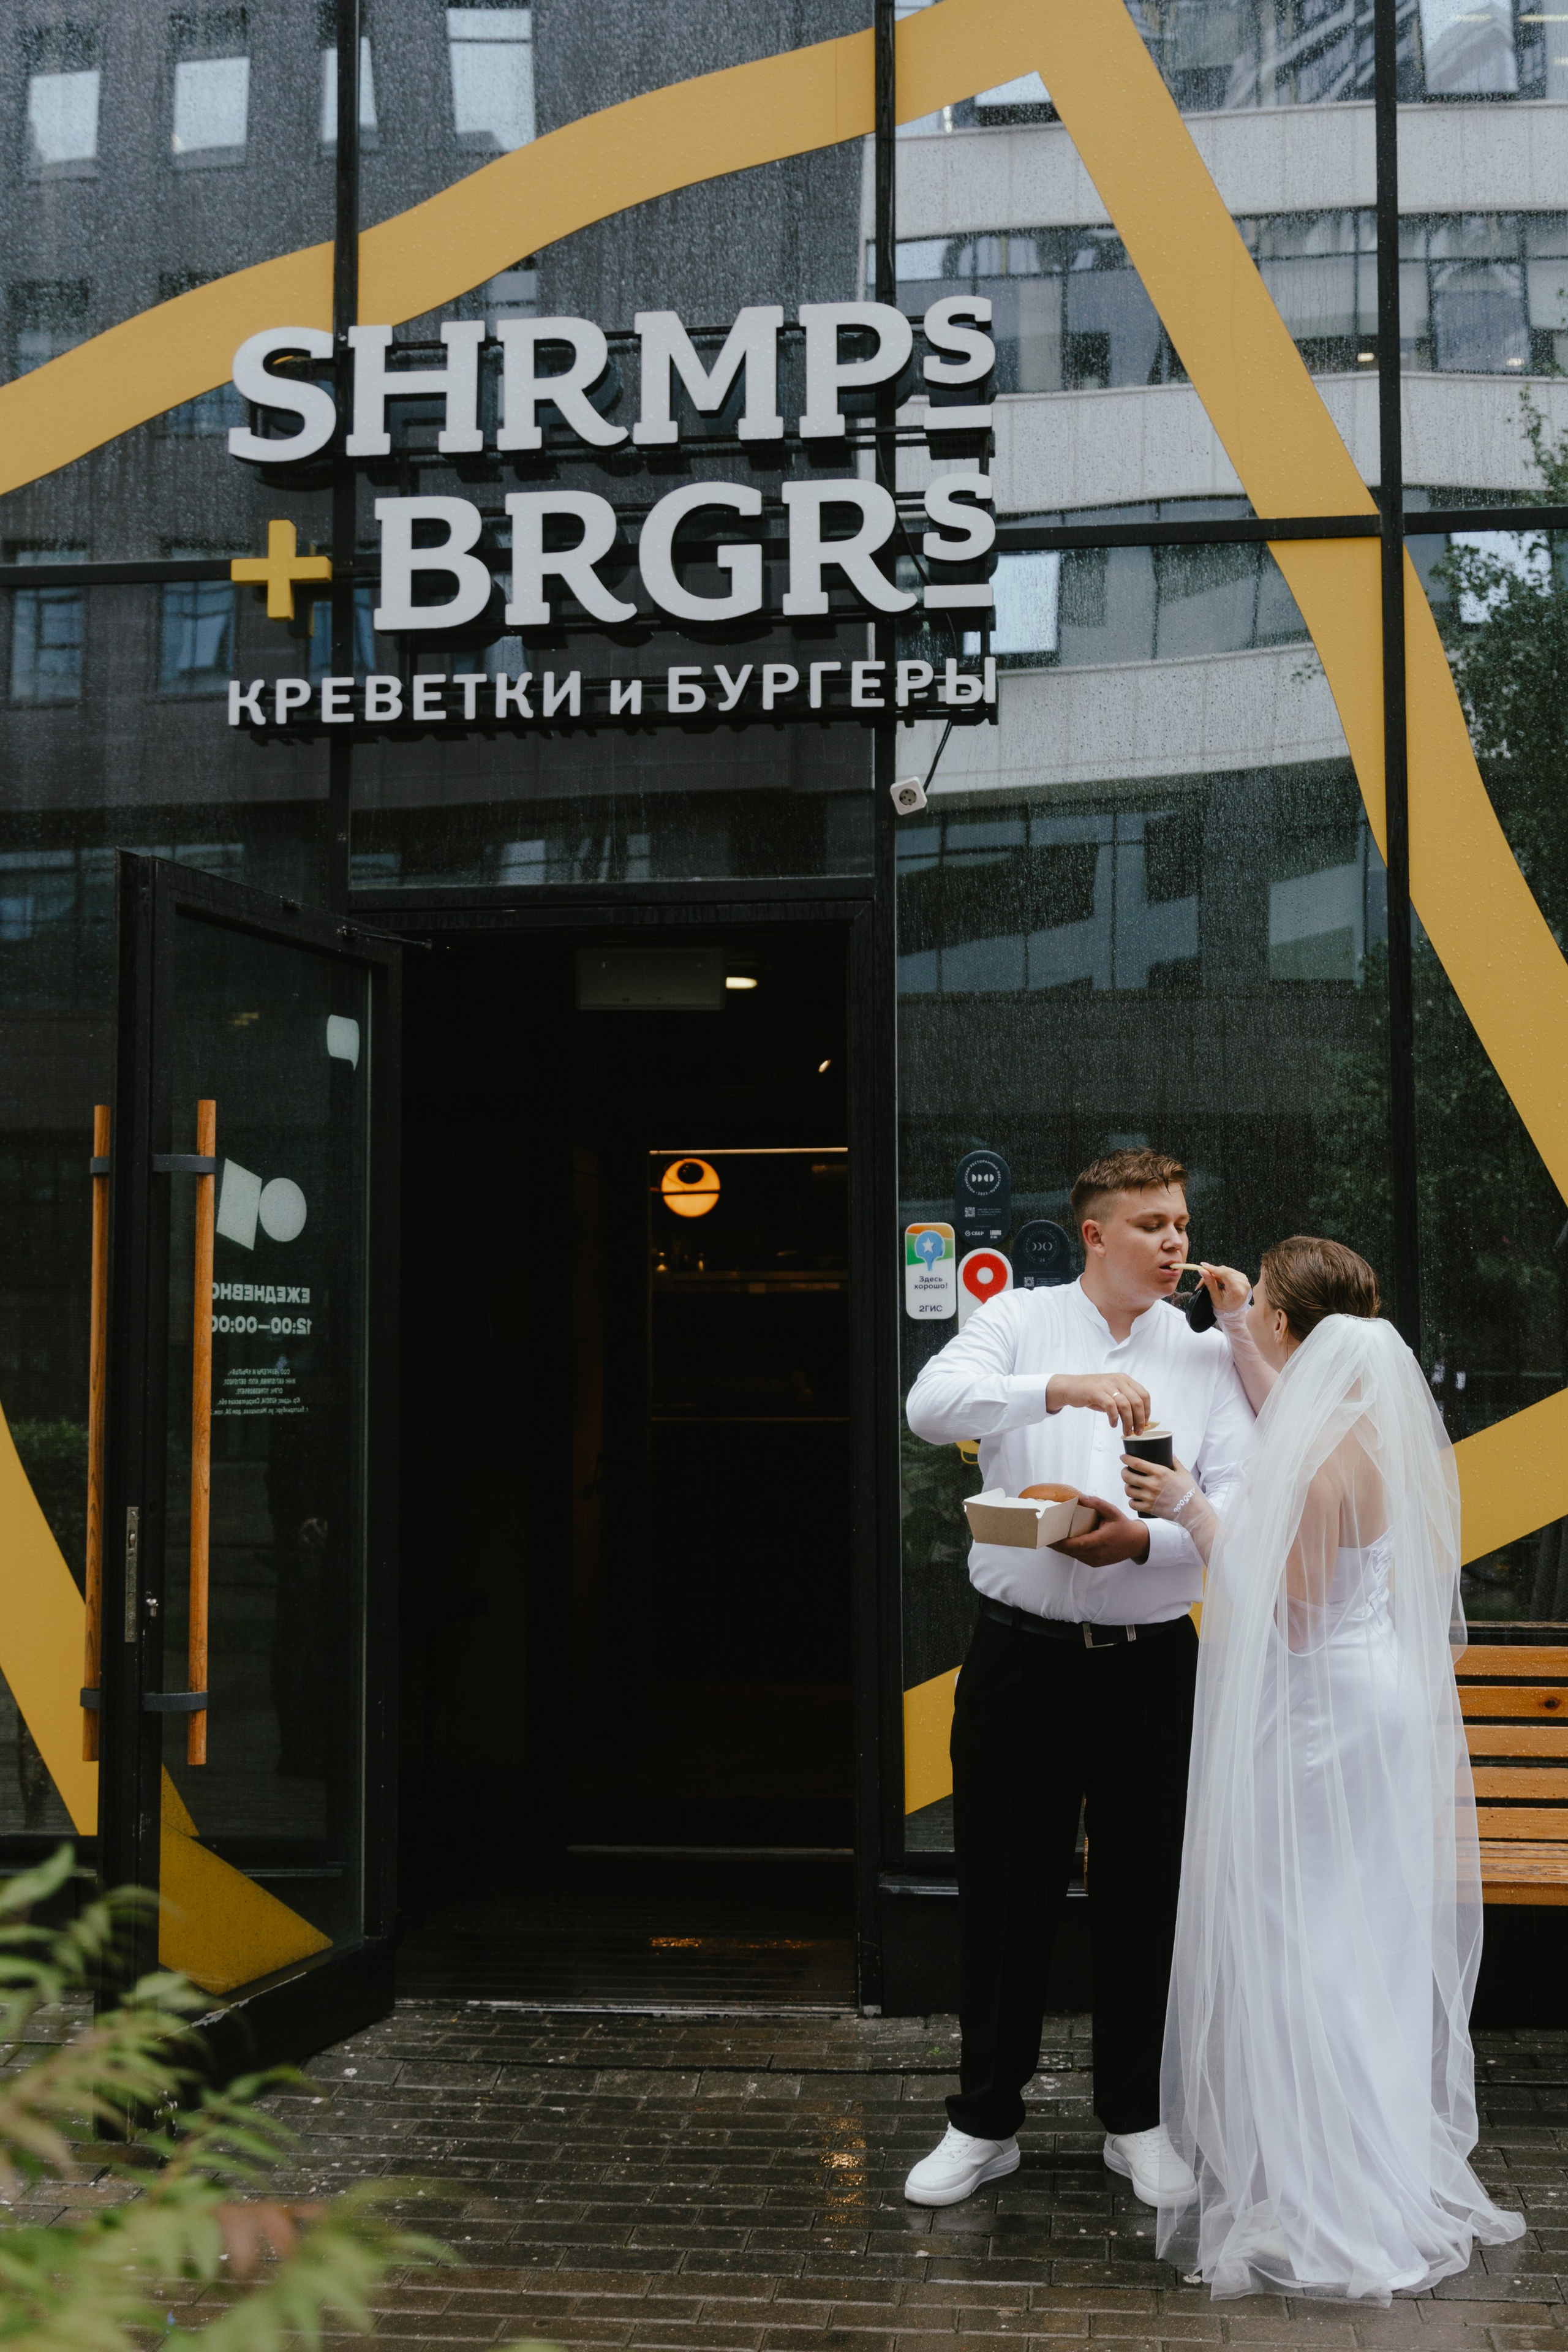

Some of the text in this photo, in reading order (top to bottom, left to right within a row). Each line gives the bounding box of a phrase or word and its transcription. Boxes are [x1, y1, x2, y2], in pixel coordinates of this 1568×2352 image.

[227, 657, 997, 726] КРЕВЕТКИ и БУРГЕРЫ
[970, 1159, 999, 1170] РЕСТОРАННЫЙ
[990, 1170, 1001, 1193] ФЕСТИВАЛЬ
[1173, 1487, 1196, 1513] любовь
